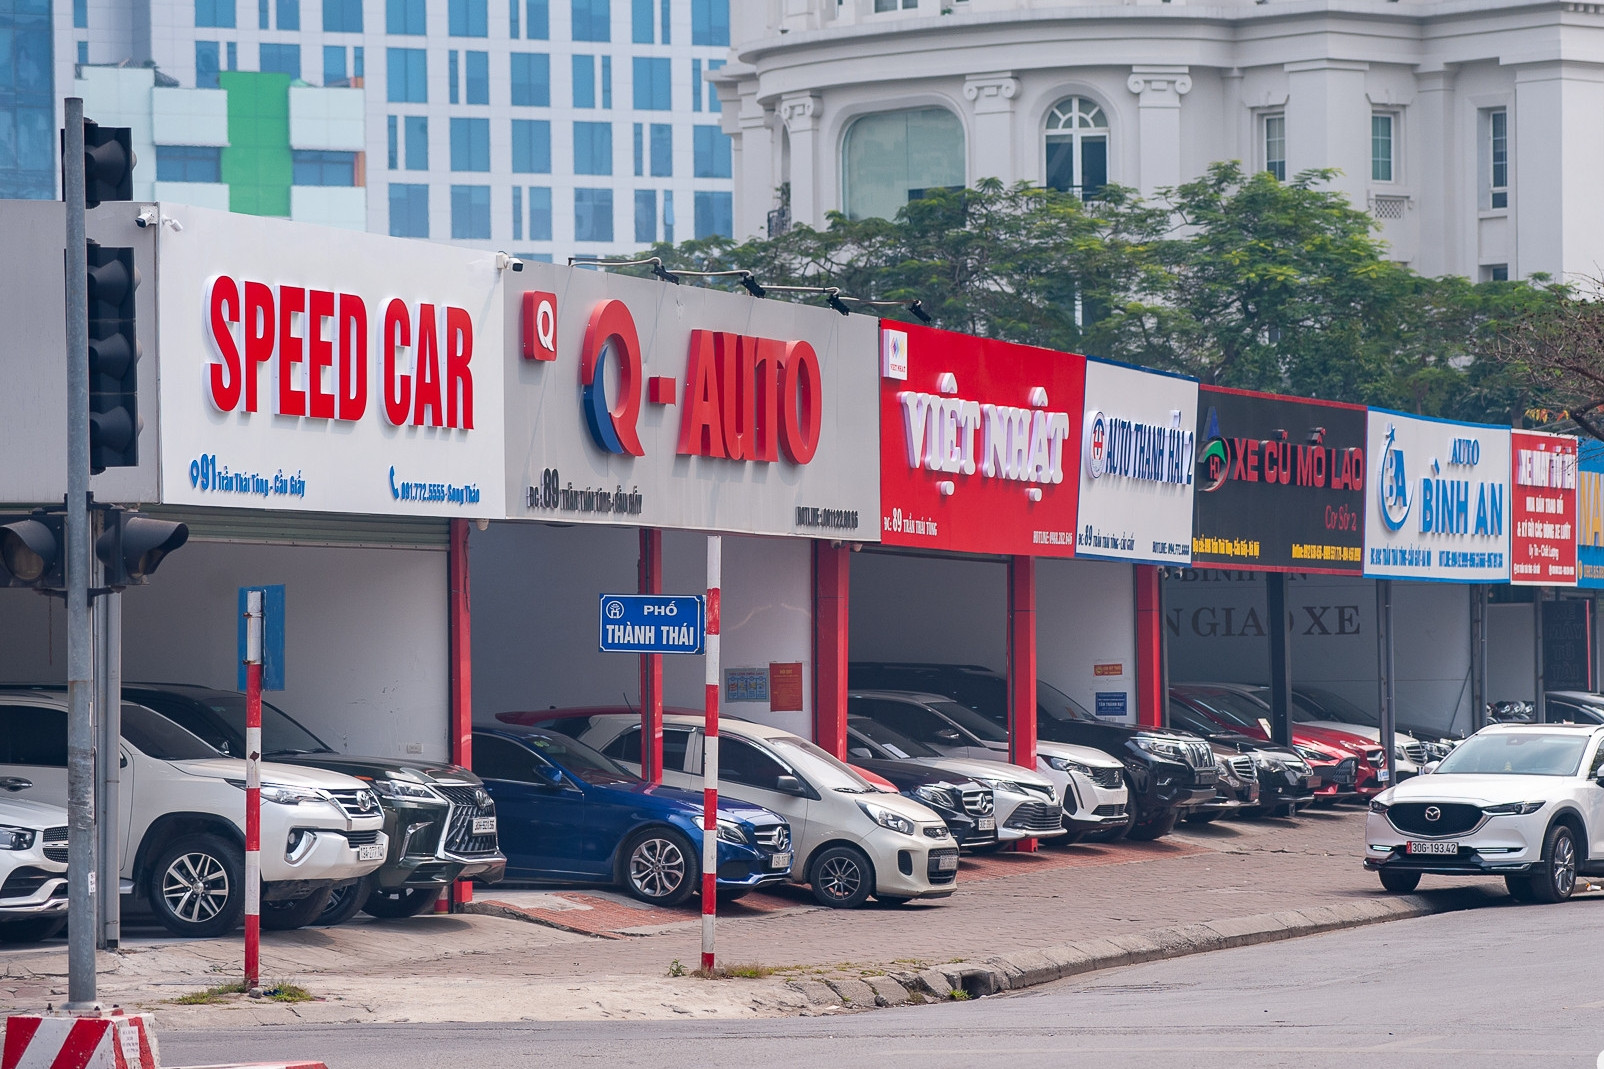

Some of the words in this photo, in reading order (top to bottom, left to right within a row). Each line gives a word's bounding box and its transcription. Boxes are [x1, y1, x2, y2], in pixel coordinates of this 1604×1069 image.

[535, 300, 554, 352] Q
[205, 275, 368, 421] SPEED
[379, 298, 474, 430] CAR
[897, 372, 980, 496] VIỆT
[980, 386, 1069, 502] NHẬT
[1105, 417, 1131, 477] AUTO
[1132, 423, 1165, 482] THANH
[1186, 431, 1194, 485] 2
[1450, 438, 1480, 466] AUTO
[200, 453, 216, 491] 91
[217, 465, 233, 491] Trần
[234, 471, 250, 493] Thái
[251, 473, 269, 497] Tông
[274, 468, 288, 495] Cầu
[289, 469, 305, 498] Giấy
[1233, 437, 1258, 482] XE
[1331, 447, 1363, 491] LAO
[1518, 449, 1532, 486] XE
[541, 467, 559, 508] 89
[1420, 458, 1469, 534] BÌNH
[1474, 482, 1503, 537] AN
[892, 507, 902, 532] 89
[1085, 524, 1093, 546] 89
[1325, 504, 1337, 529] Cơ
[1351, 512, 1357, 531] 2
[643, 600, 678, 616] PHỐ
[1302, 605, 1360, 636] XE
[606, 621, 656, 645] THÀNH
[660, 622, 694, 646] THÁI
